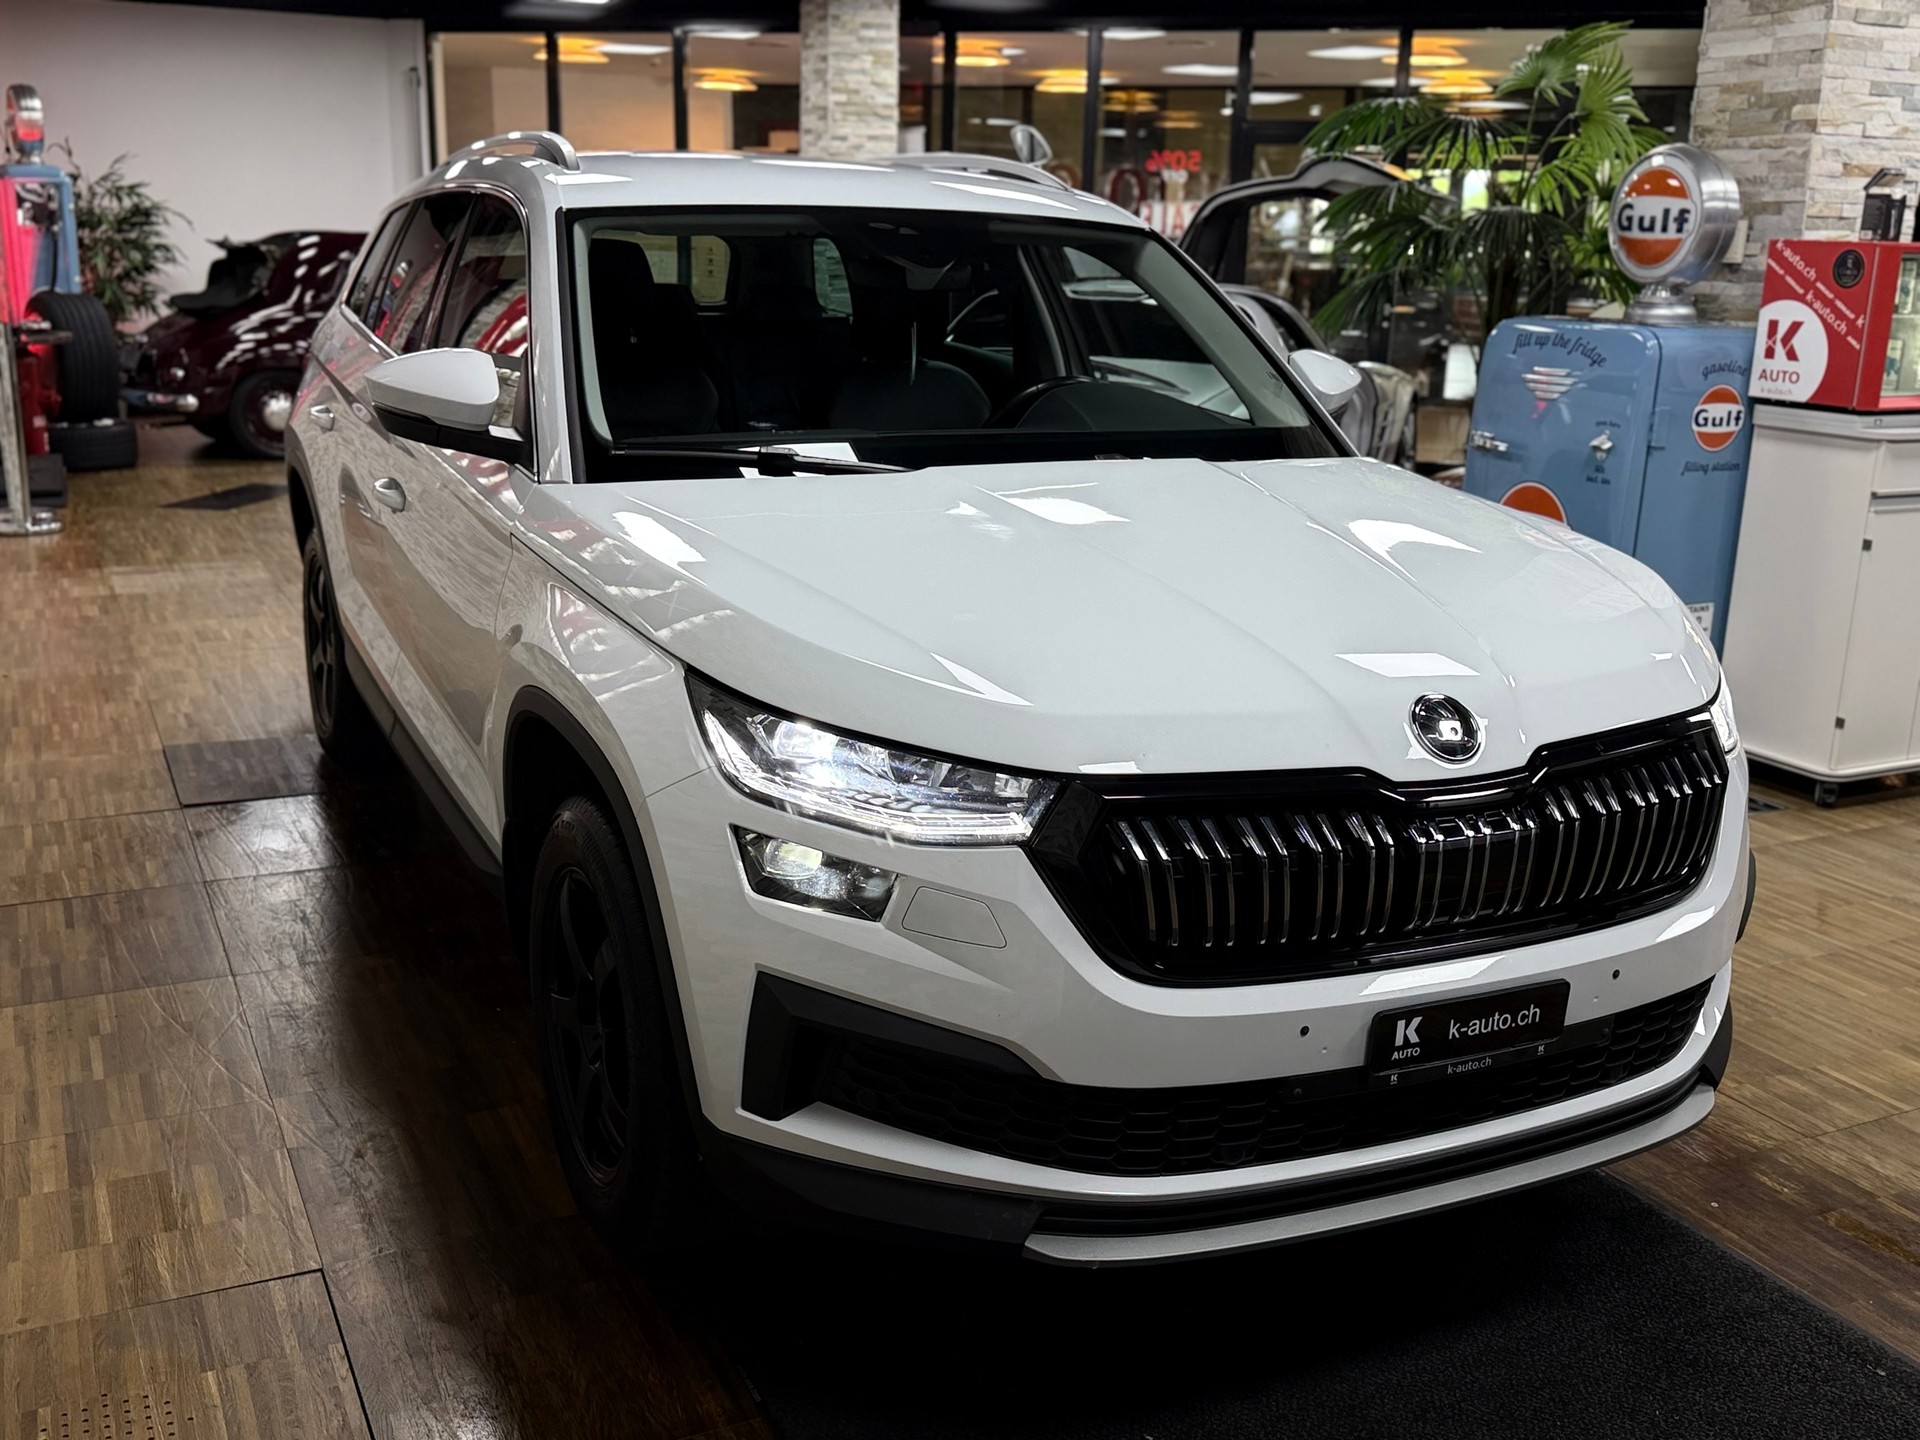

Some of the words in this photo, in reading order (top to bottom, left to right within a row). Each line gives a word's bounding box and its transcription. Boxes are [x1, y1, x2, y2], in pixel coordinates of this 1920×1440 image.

[1617, 202, 1691, 234] Gulf
[1775, 239, 1817, 281] k-auto.ch
[1805, 289, 1847, 335] k-auto.ch
[1512, 333, 1531, 355] fill
[1534, 333, 1550, 350] up
[1552, 333, 1570, 349] the
[1566, 336, 1607, 368] fridge
[1764, 319, 1805, 362] K
[1701, 360, 1748, 381] gasoline
[1758, 368, 1800, 384] AUTO
[1694, 409, 1743, 427] Gulf
[1680, 460, 1709, 476] filling
[1711, 462, 1740, 472] station
[1394, 1016, 1423, 1046] K
[1448, 1004, 1541, 1040] k-auto.ch
[1391, 1047, 1420, 1061] AUTO
[1447, 1057, 1492, 1075] k-auto.ch
